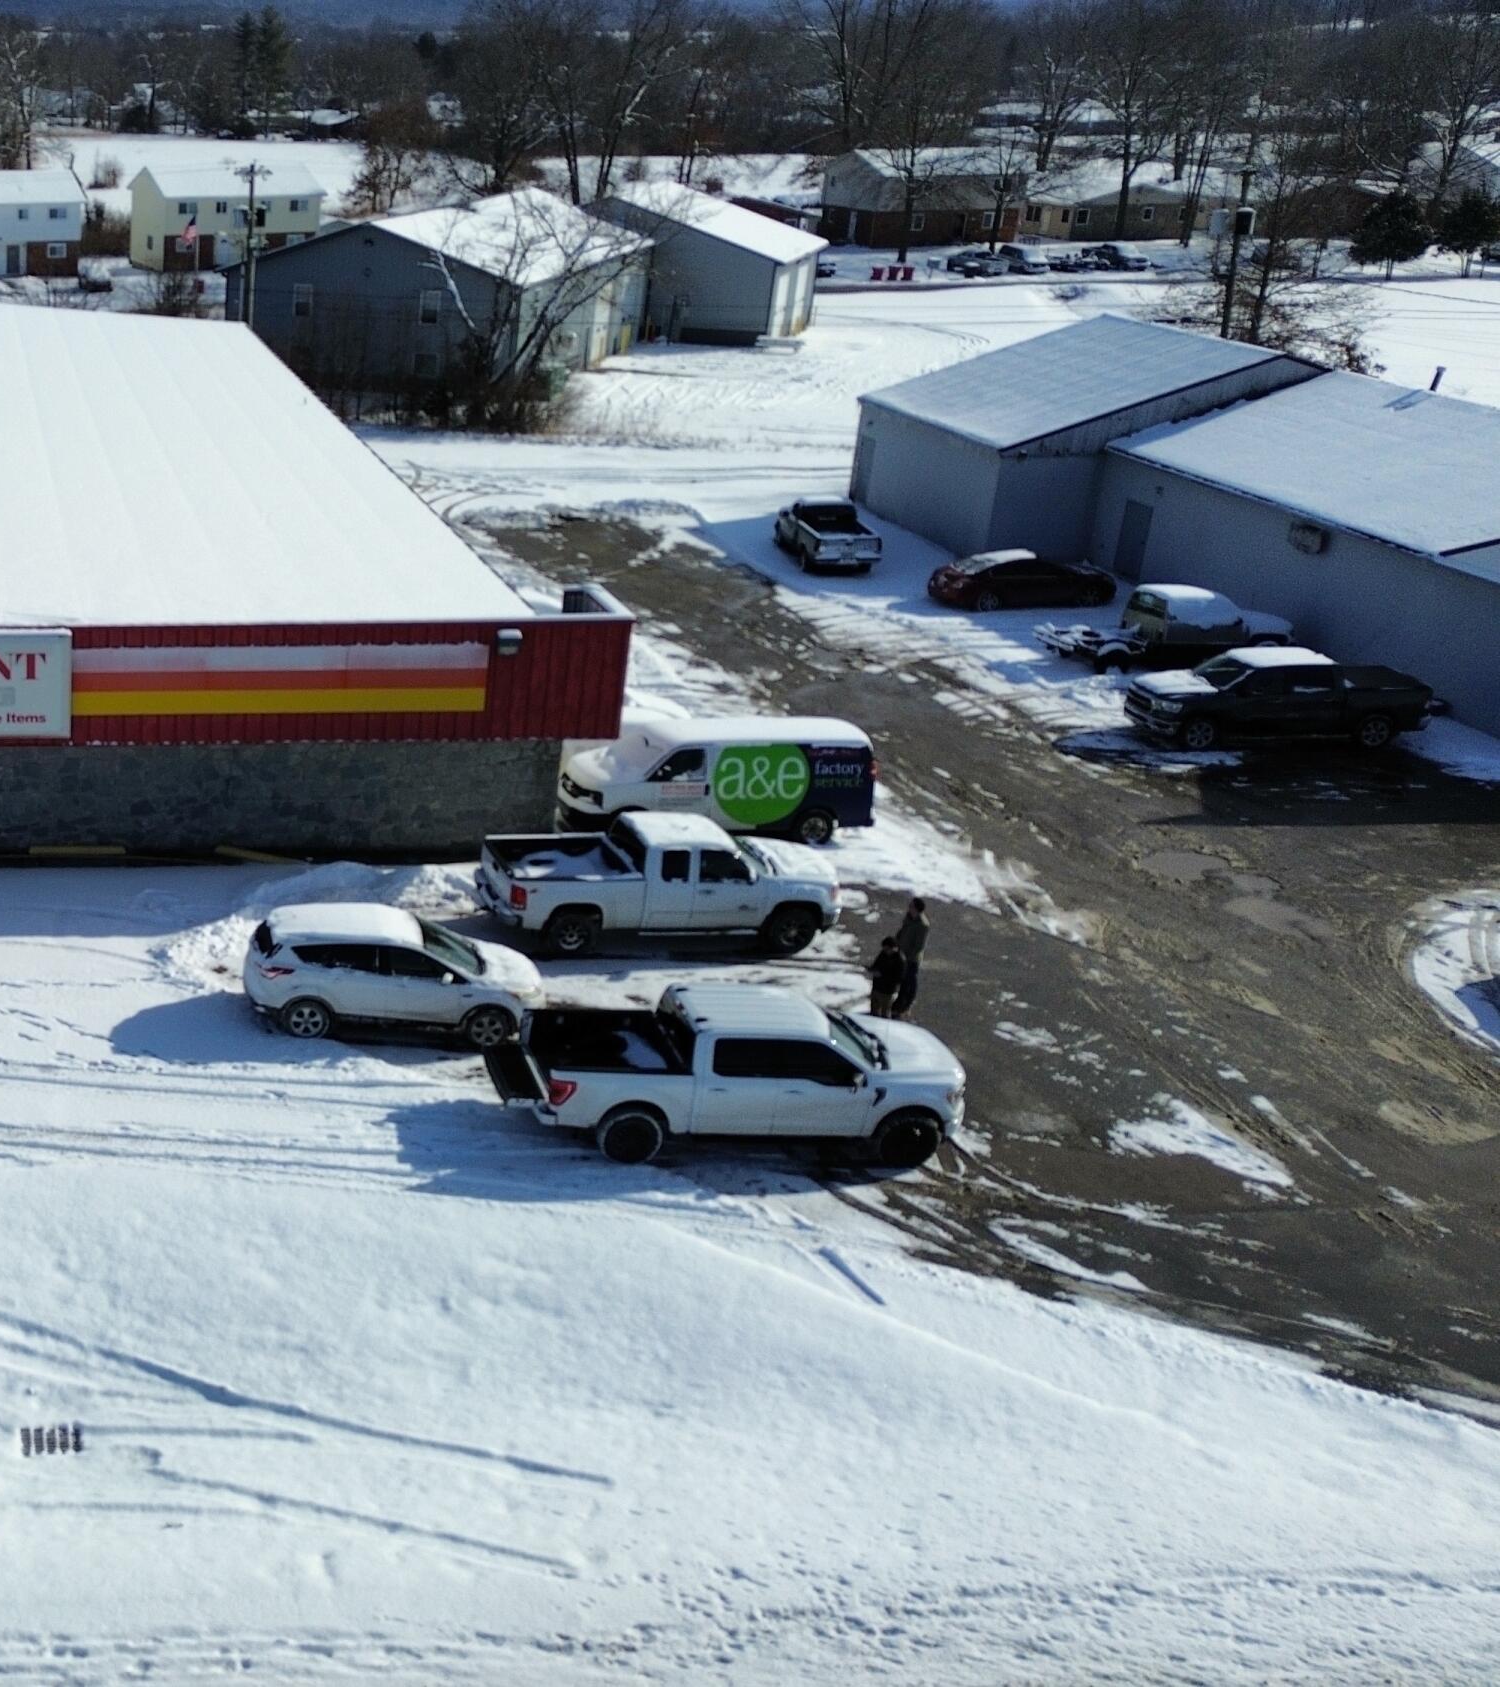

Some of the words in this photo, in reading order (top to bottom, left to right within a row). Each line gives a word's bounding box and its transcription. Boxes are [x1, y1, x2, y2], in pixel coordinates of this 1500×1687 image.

[6, 713, 47, 724] Items
[717, 756, 806, 800] a&e
[815, 760, 864, 778] factory
